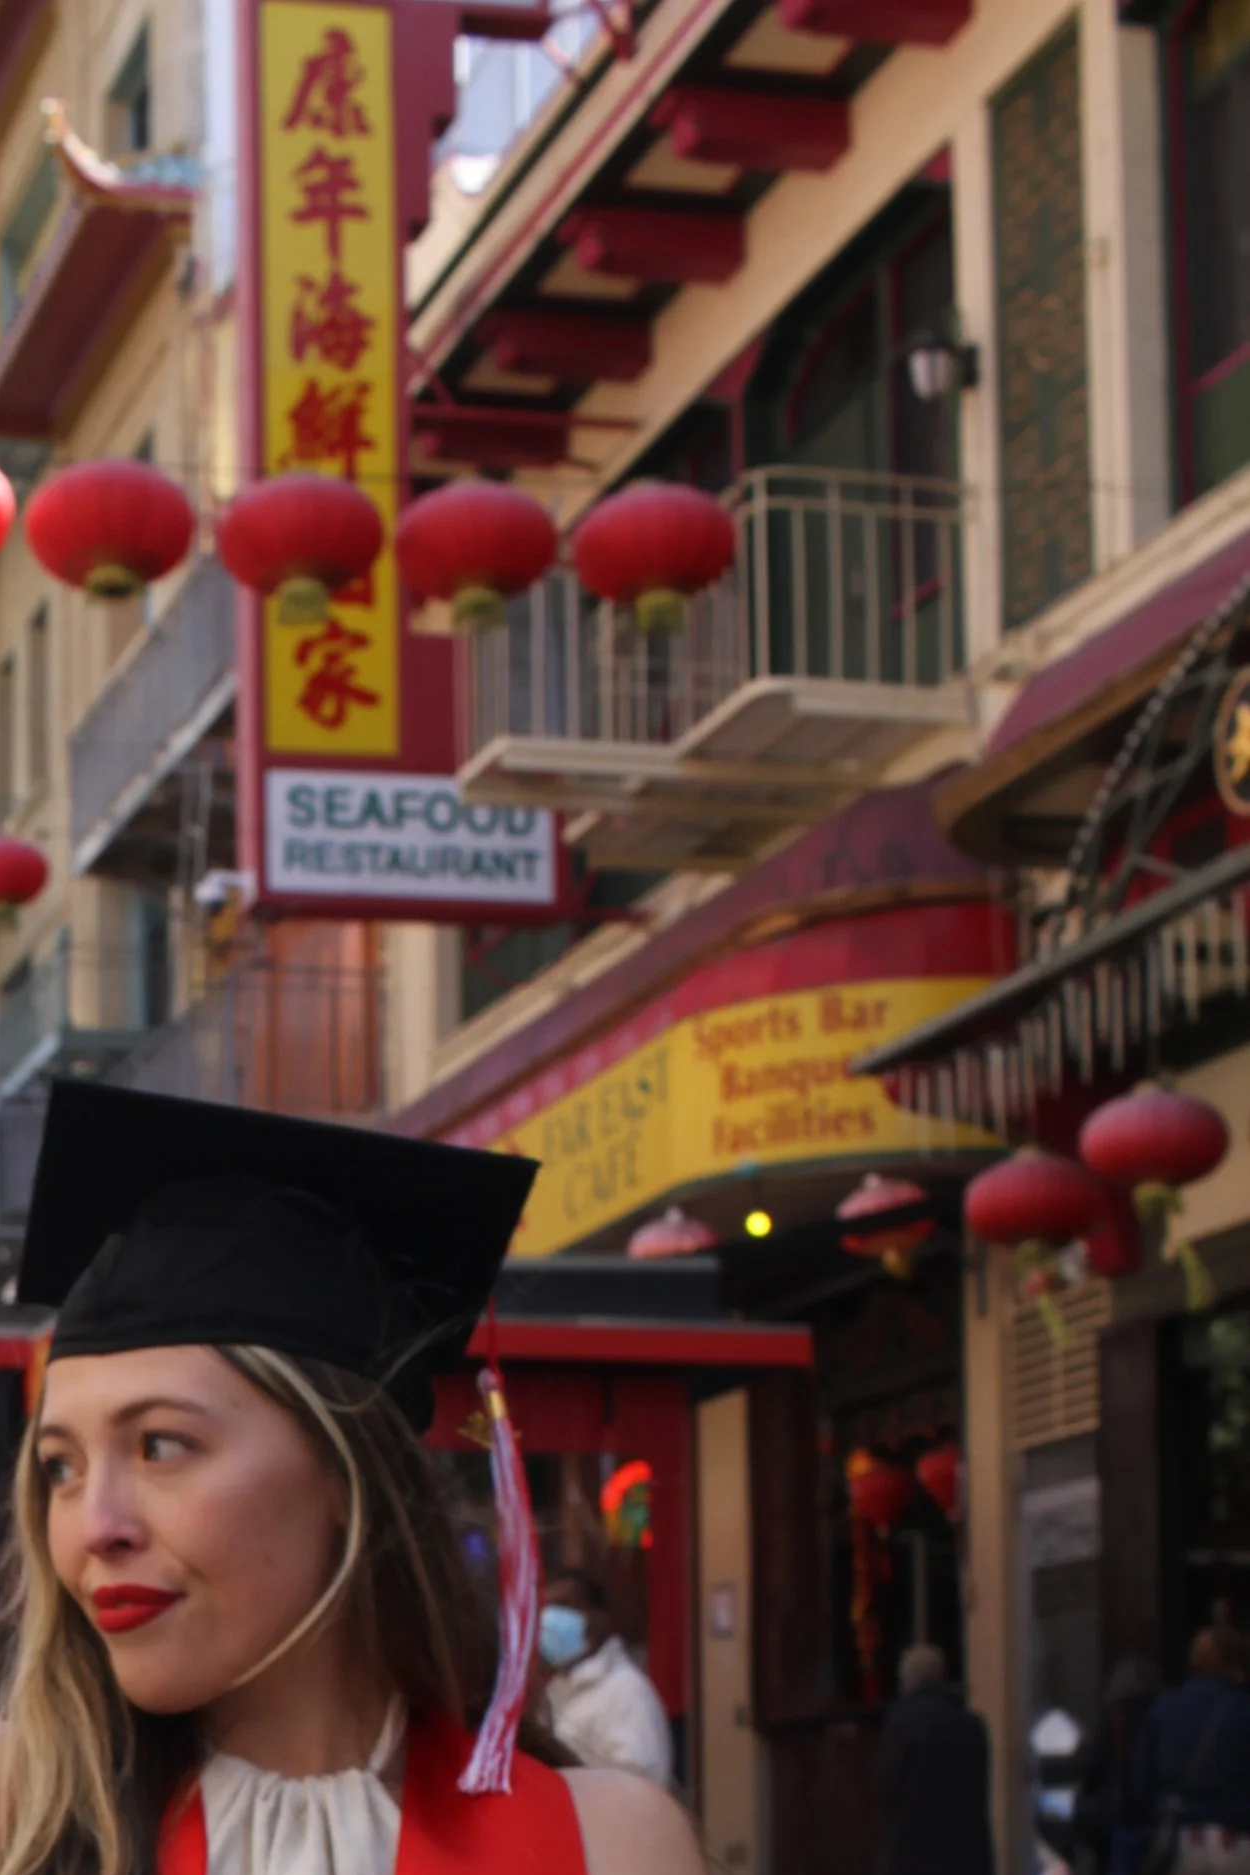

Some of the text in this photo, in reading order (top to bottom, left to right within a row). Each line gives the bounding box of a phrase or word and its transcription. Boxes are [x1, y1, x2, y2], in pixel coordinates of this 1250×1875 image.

[281, 24, 382, 732] 康年海鮮家
[286, 783, 538, 838] SEAFOOD
[281, 837, 543, 883] RESTAURANT
[694, 991, 891, 1062] Sports Bar
